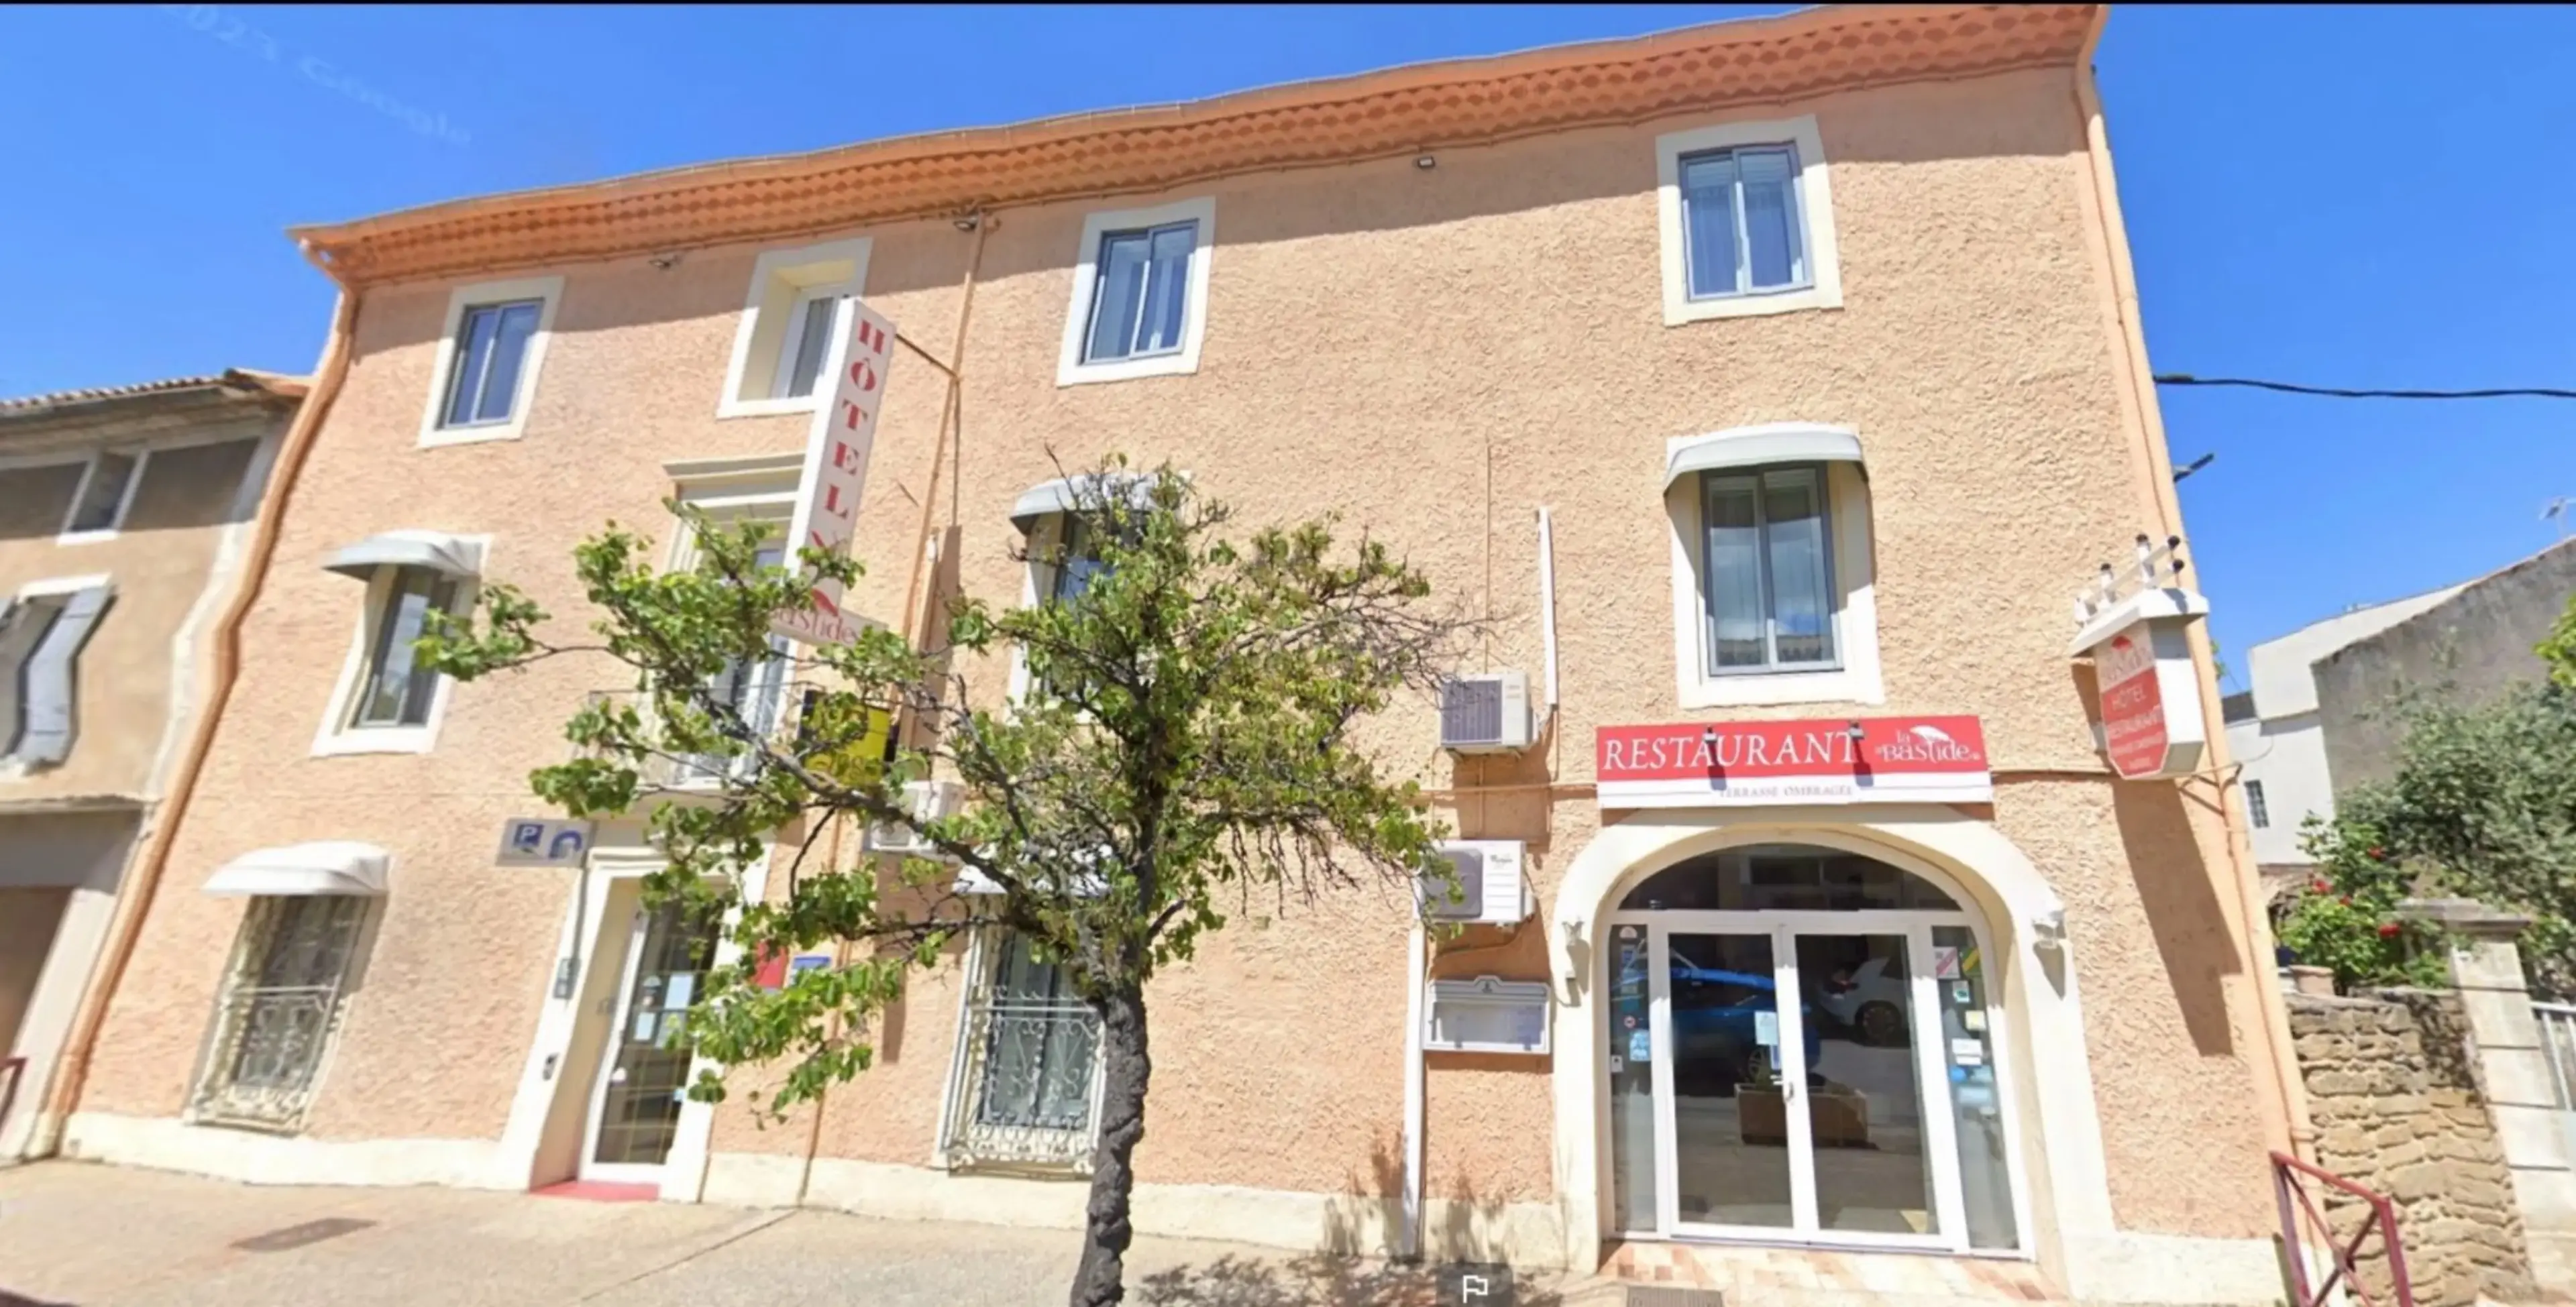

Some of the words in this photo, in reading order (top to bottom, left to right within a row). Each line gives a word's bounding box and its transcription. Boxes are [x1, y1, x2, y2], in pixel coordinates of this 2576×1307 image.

[824, 319, 885, 520] HÔTEL
[1602, 730, 1860, 771] RESTAURANT
[1896, 728, 1911, 744] la
